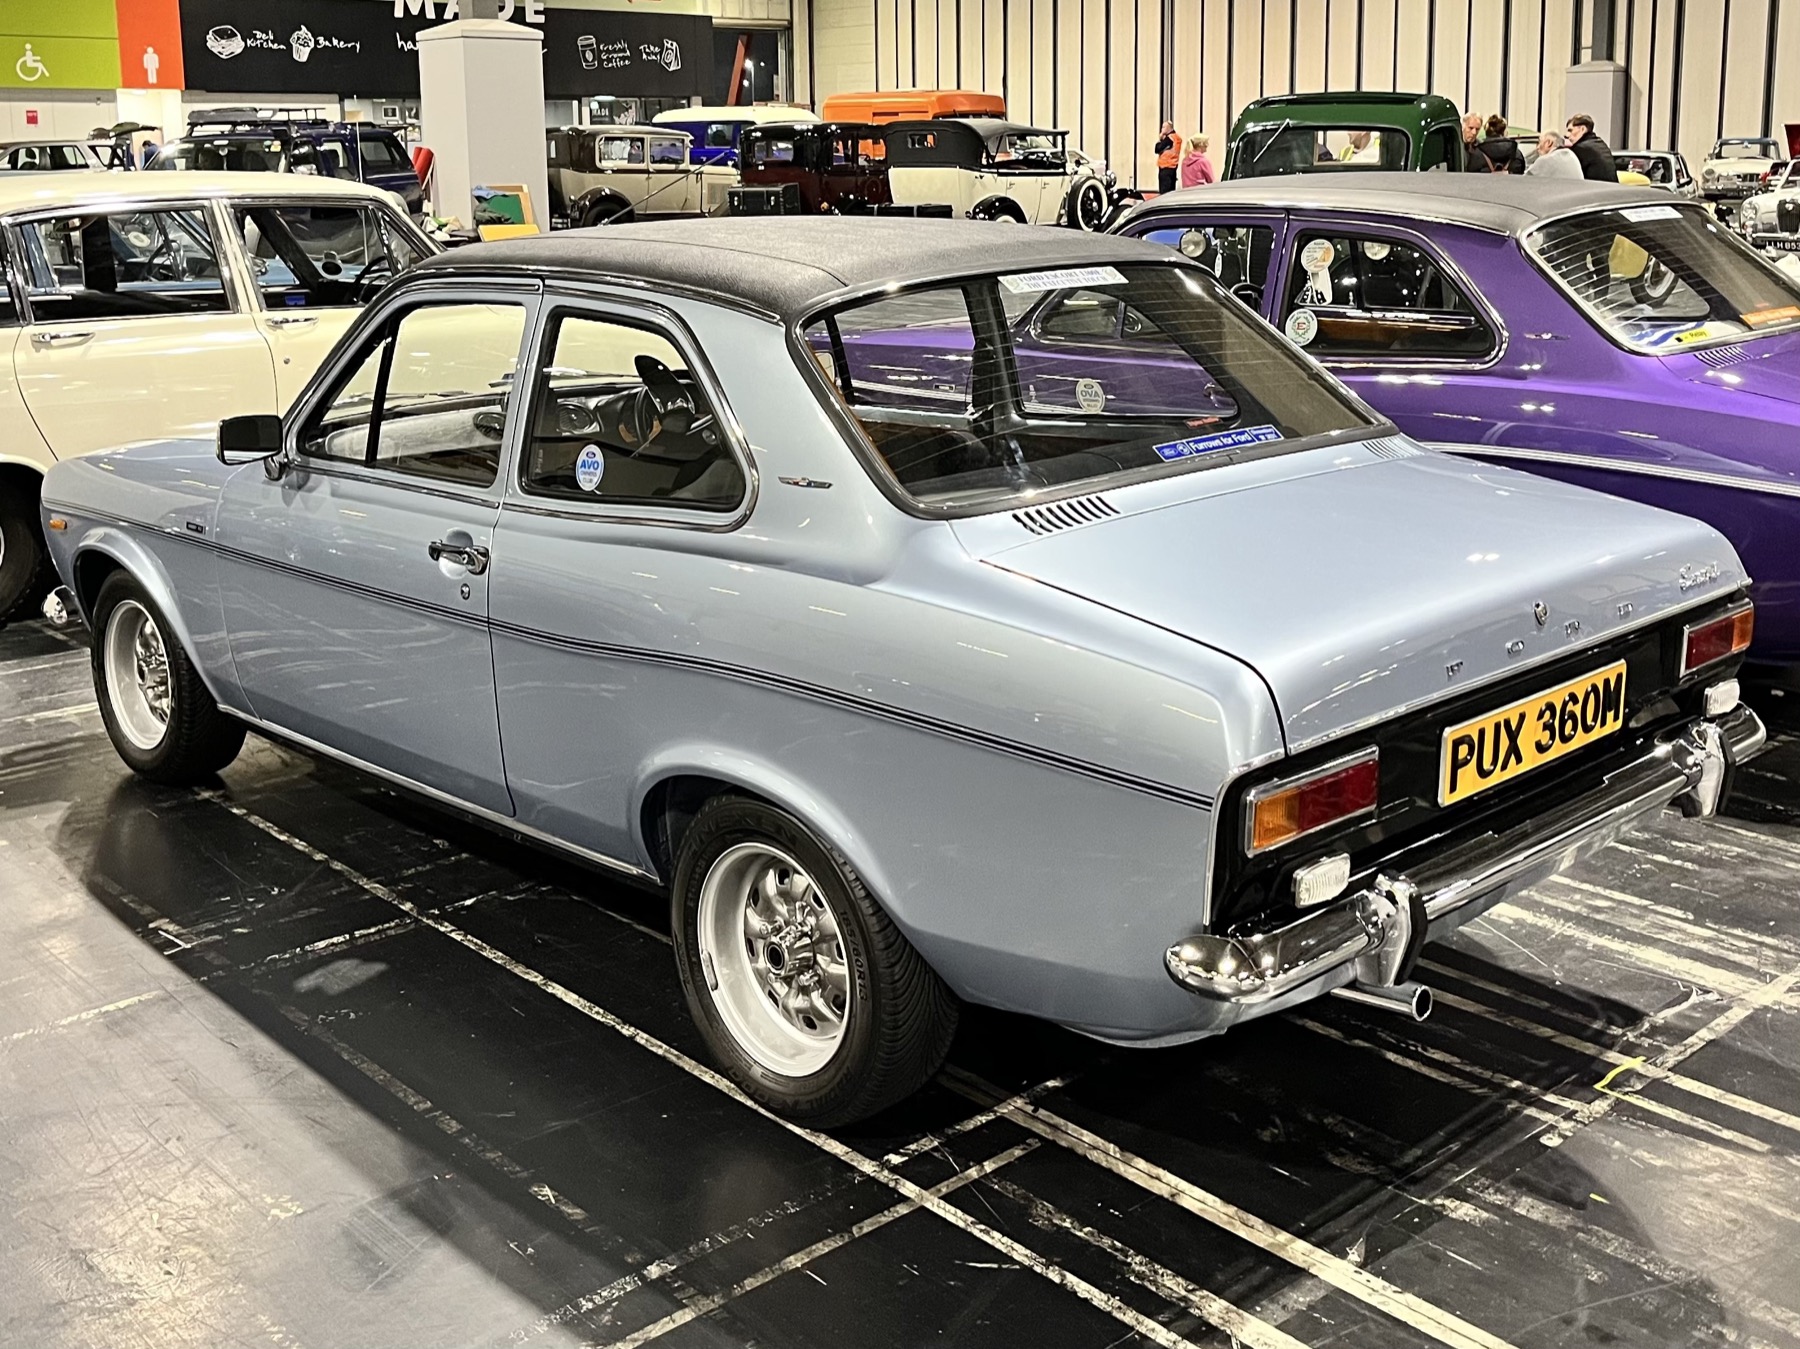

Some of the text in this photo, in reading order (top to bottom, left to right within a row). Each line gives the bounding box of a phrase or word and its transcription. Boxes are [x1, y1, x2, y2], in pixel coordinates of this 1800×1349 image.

[252, 30, 274, 40] Deli
[246, 38, 287, 50] Kitchen
[316, 36, 361, 53] Bakery
[600, 39, 629, 51] Freshly
[639, 44, 661, 53] Take
[600, 49, 631, 60] Ground
[642, 53, 661, 62] Away
[603, 59, 631, 68] Coffee
[1232, 433, 1253, 444] Ford
[580, 459, 600, 471] AVO
[1449, 671, 1624, 795] PUX 360M
